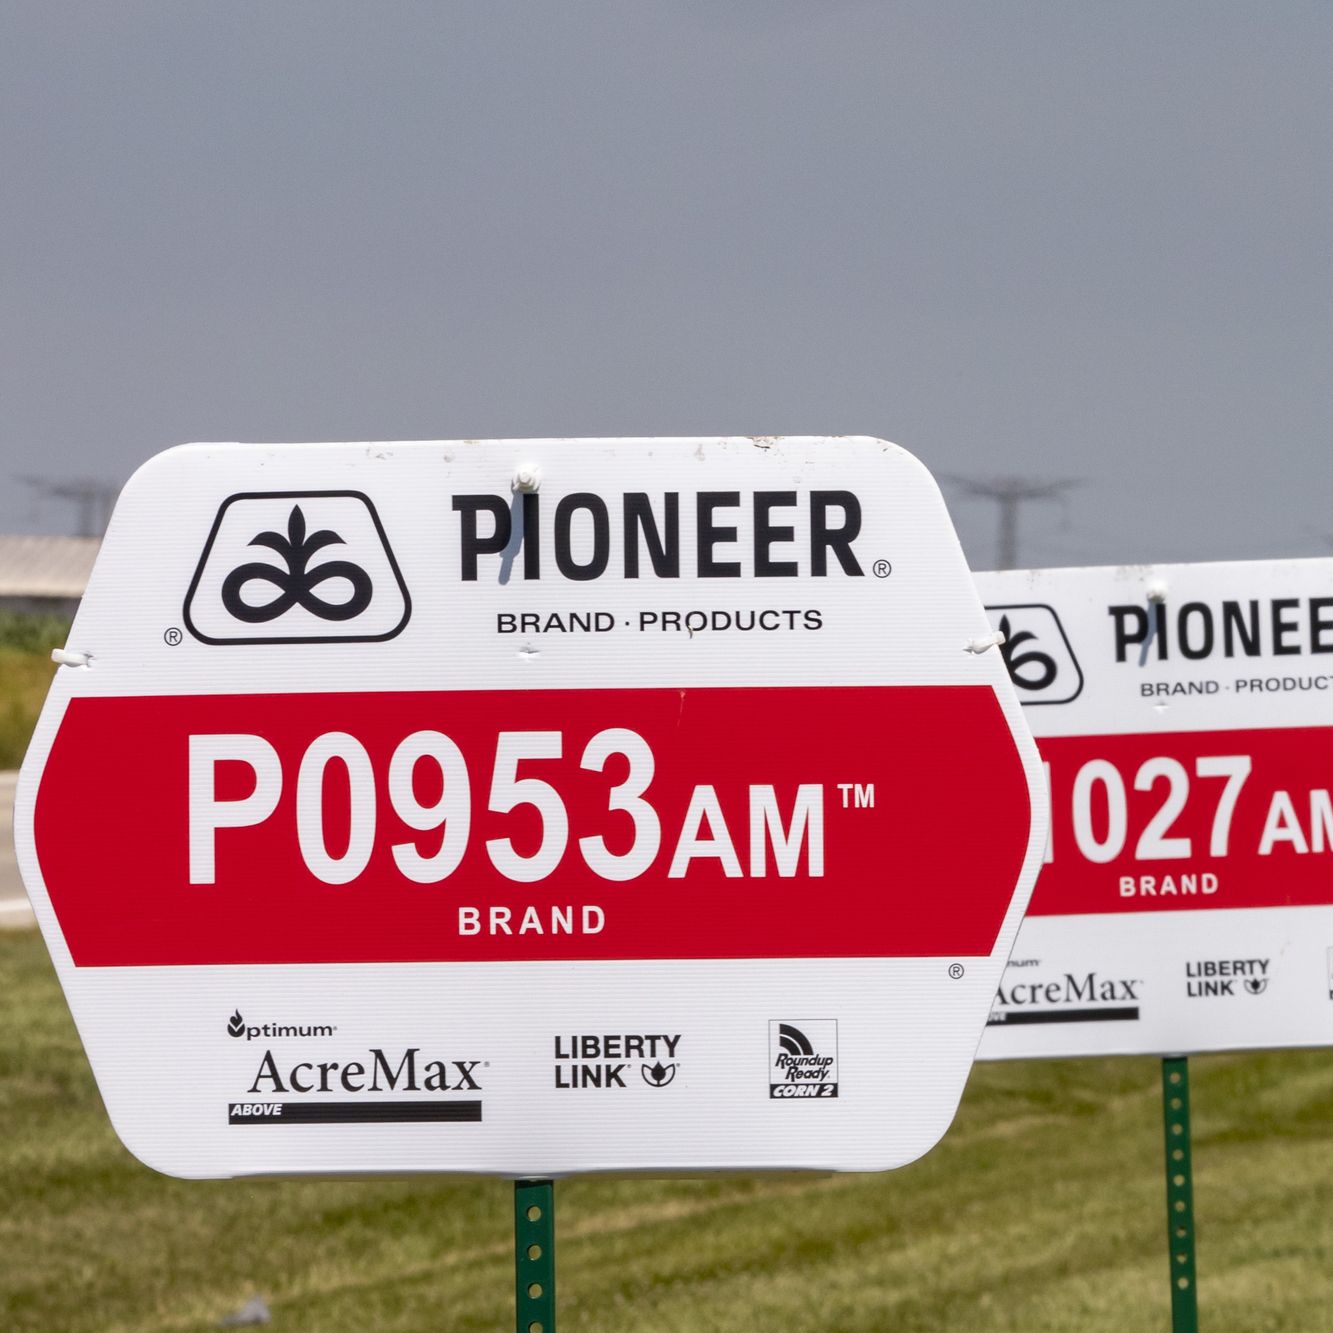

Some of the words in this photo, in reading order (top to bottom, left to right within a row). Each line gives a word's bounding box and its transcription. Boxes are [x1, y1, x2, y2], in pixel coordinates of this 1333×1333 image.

[496, 612, 615, 635] BRAND
[638, 609, 824, 633] PRODUCTS
[1140, 680, 1220, 697] BRAND
[1118, 872, 1219, 898] BRAND
[457, 905, 606, 936] BRAND
[1185, 958, 1270, 978] LIBERTY
[1186, 979, 1235, 998] LINK
[554, 1034, 682, 1059] LIBERTY
[774, 1052, 834, 1069] Roundup
[554, 1064, 627, 1089] LINK
[784, 1065, 831, 1083] Ready
[772, 1084, 819, 1098] CORN
[820, 1083, 835, 1097] 2
[230, 1103, 283, 1117] ABOVE
